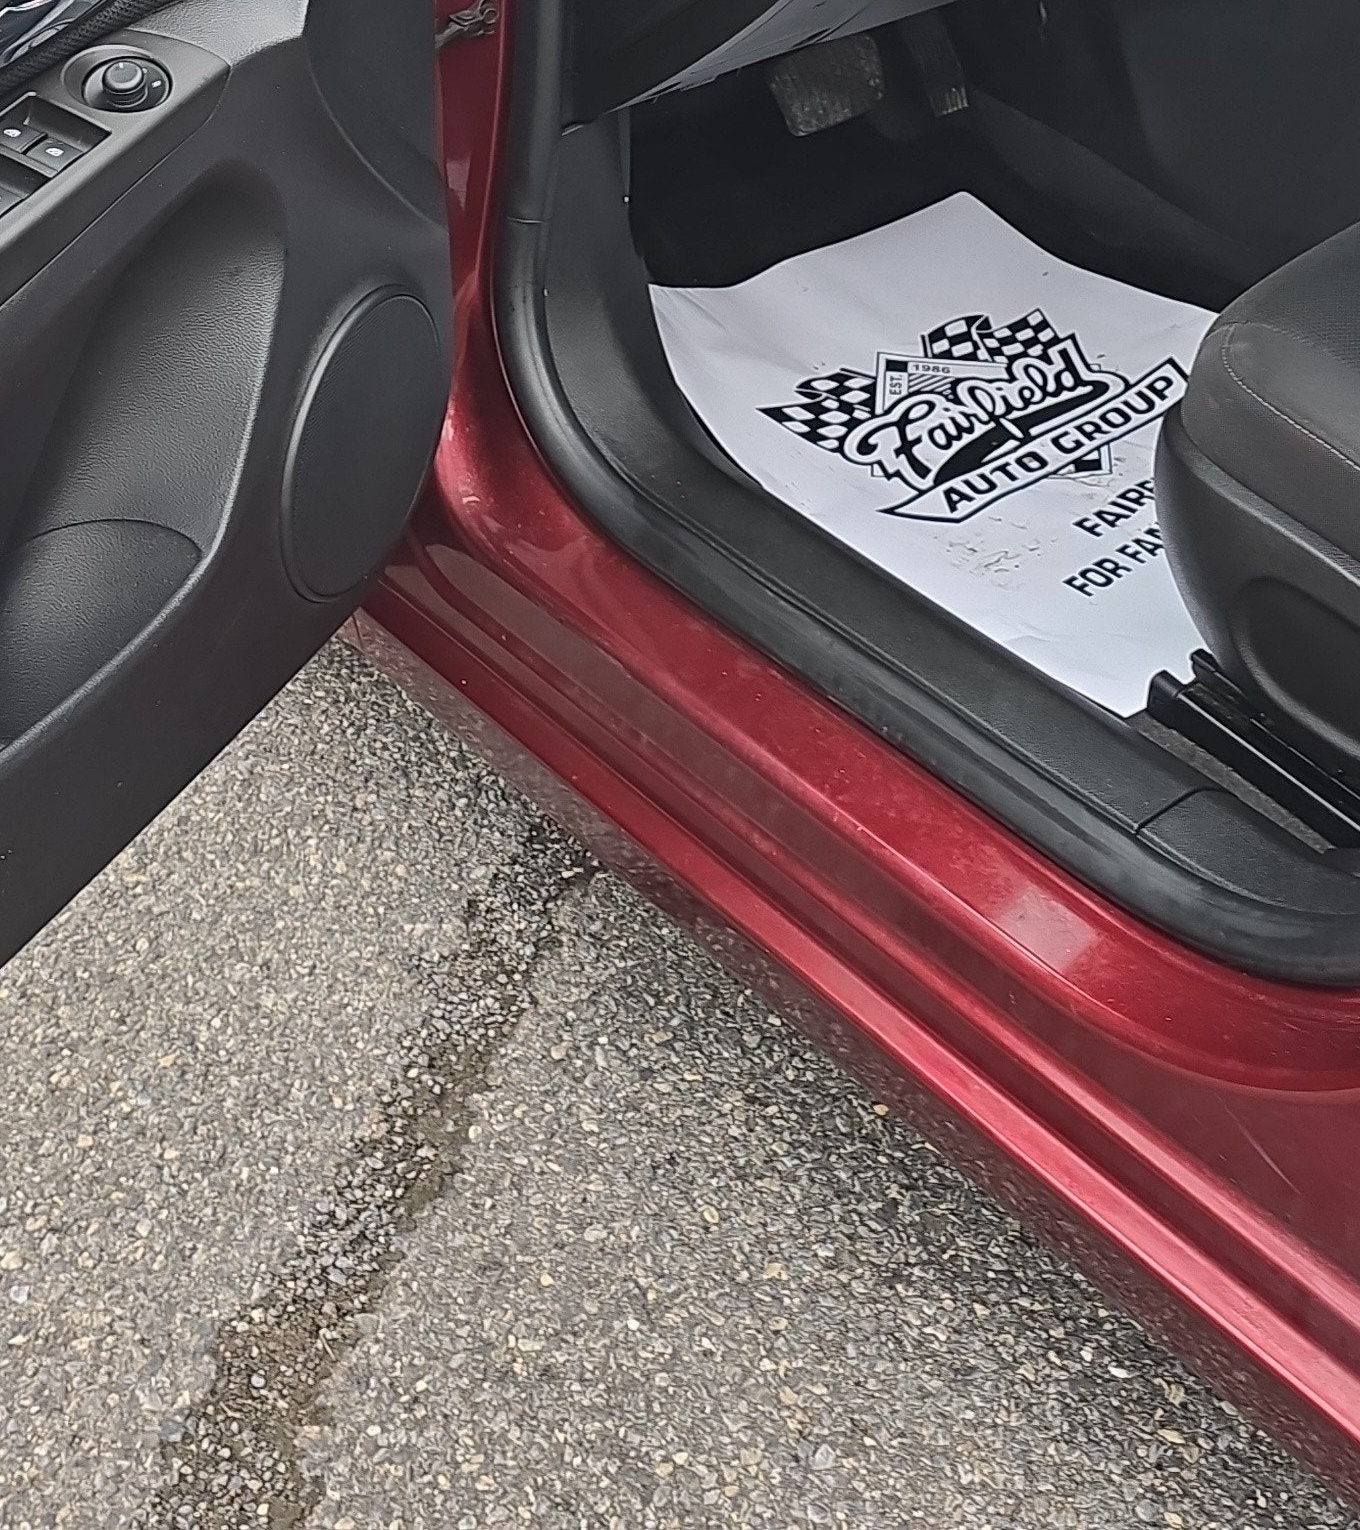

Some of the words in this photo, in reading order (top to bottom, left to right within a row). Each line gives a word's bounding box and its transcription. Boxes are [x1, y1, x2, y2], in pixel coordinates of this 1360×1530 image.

[912, 364, 951, 374] 1986
[856, 346, 1084, 480] Fairfield
[940, 450, 1050, 513] AUTO
[1049, 375, 1175, 456] GROUP
[1062, 557, 1133, 597] FOR
